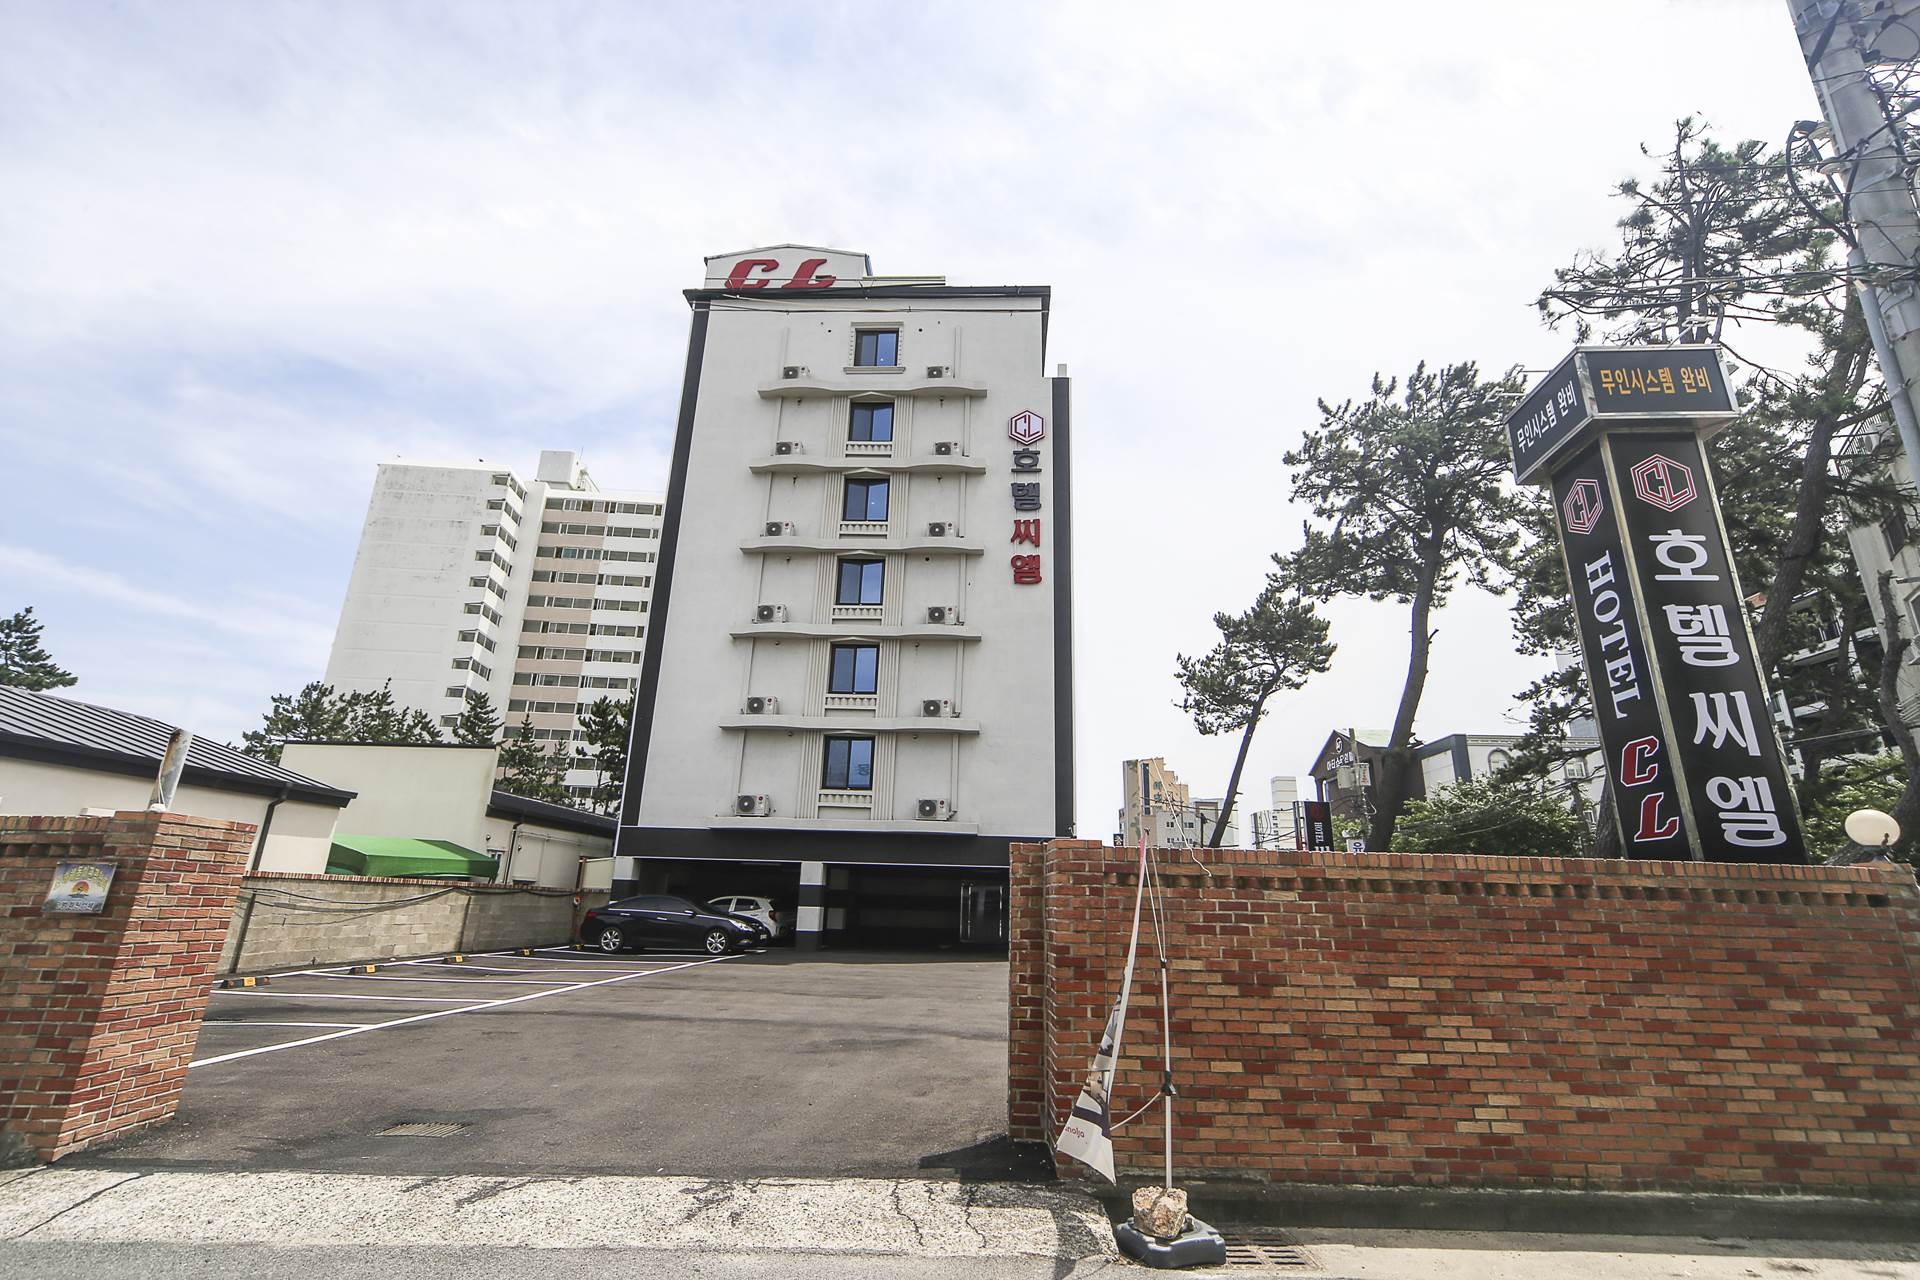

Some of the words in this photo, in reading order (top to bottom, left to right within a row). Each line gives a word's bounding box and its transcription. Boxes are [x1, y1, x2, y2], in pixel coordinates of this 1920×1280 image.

[724, 258, 837, 289] CL
[1599, 367, 1676, 396] 무인시스템
[1680, 366, 1713, 393] 완비
[1516, 399, 1558, 453] 무인시스템
[1557, 380, 1578, 417] 완비
[1584, 550, 1641, 719] HOTEL
[1313, 821, 1325, 844] HOTEL
